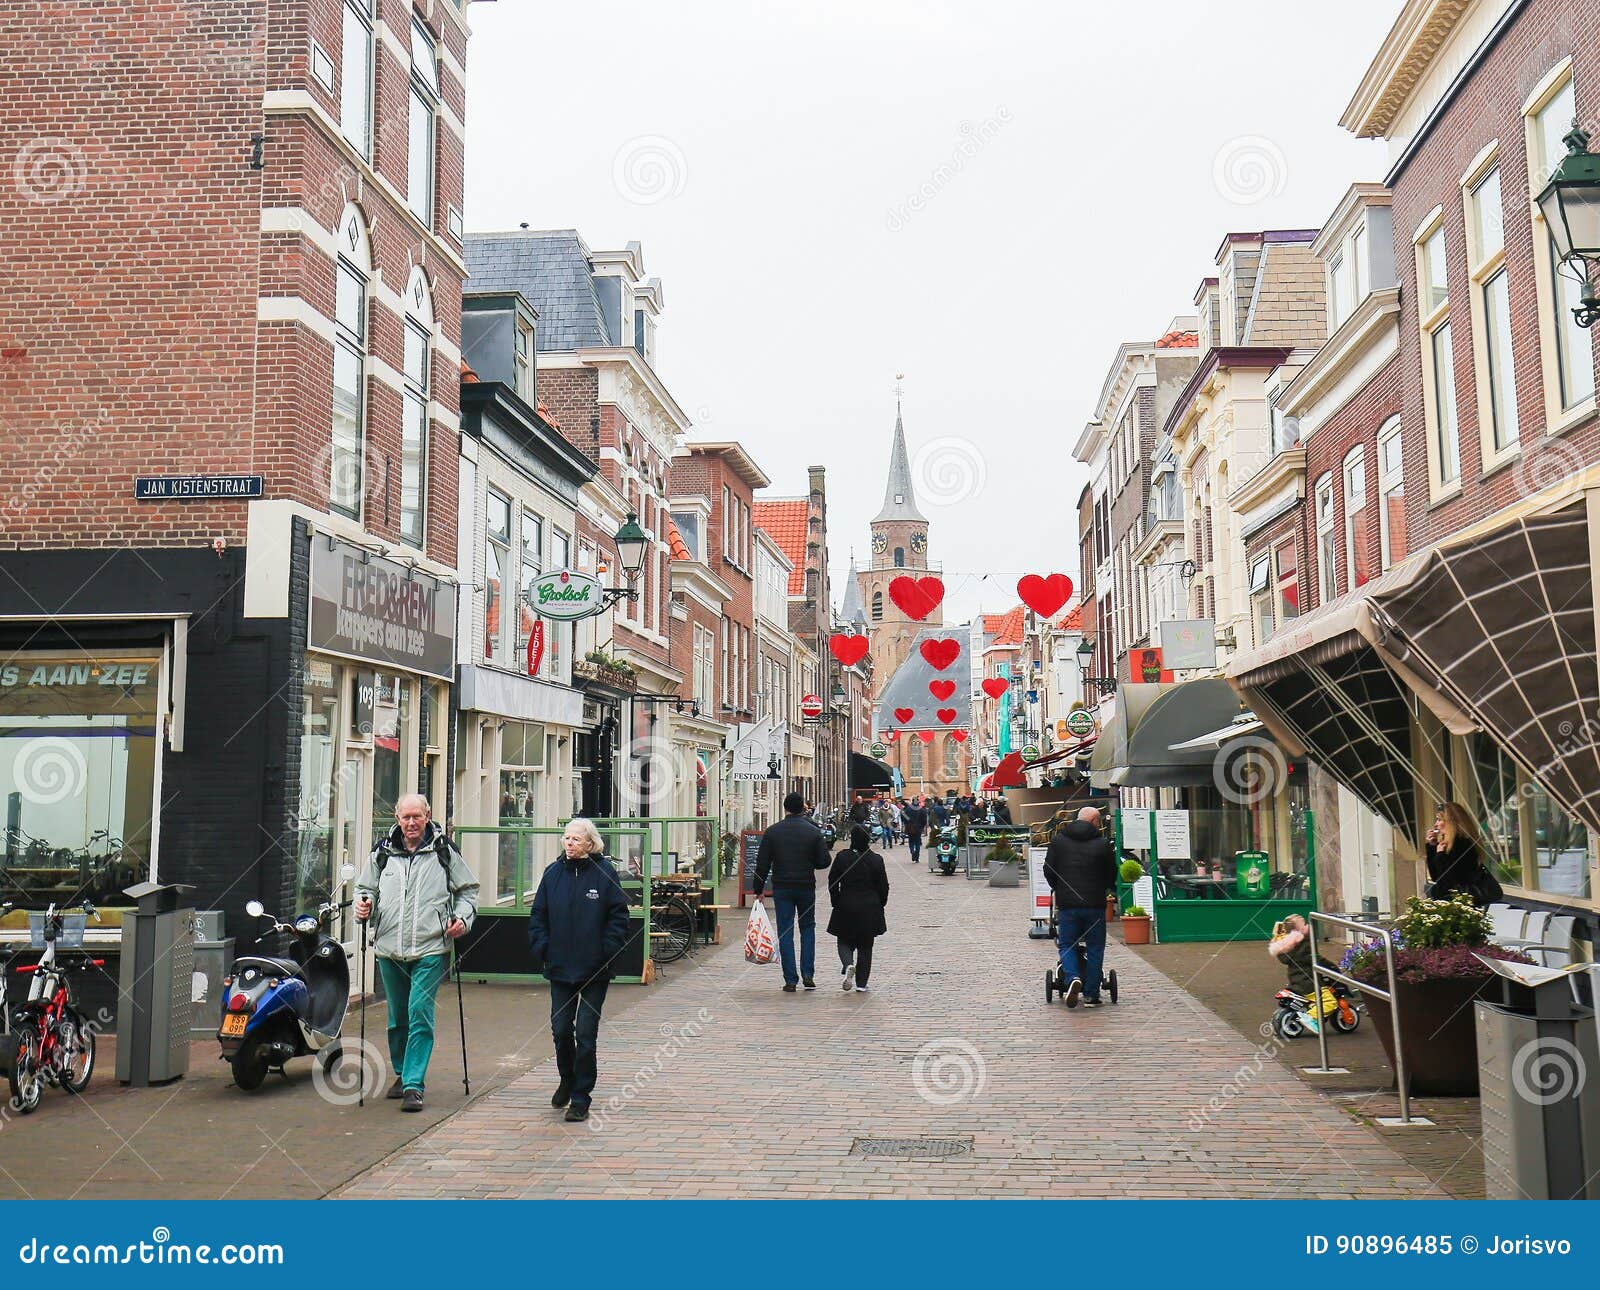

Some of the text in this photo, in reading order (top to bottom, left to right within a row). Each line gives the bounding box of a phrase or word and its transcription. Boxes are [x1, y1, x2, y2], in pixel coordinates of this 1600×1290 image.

[143, 479, 253, 495] JAN KISTENSTRAAT
[341, 554, 436, 633] FRED&REMI
[537, 582, 591, 605] Grolsch
[340, 609, 425, 657] kappers aan zee
[530, 625, 541, 670] VEDETT
[0, 664, 150, 687] S AAN ZEE
[358, 685, 374, 711] 103
[734, 772, 767, 780] FESTON
